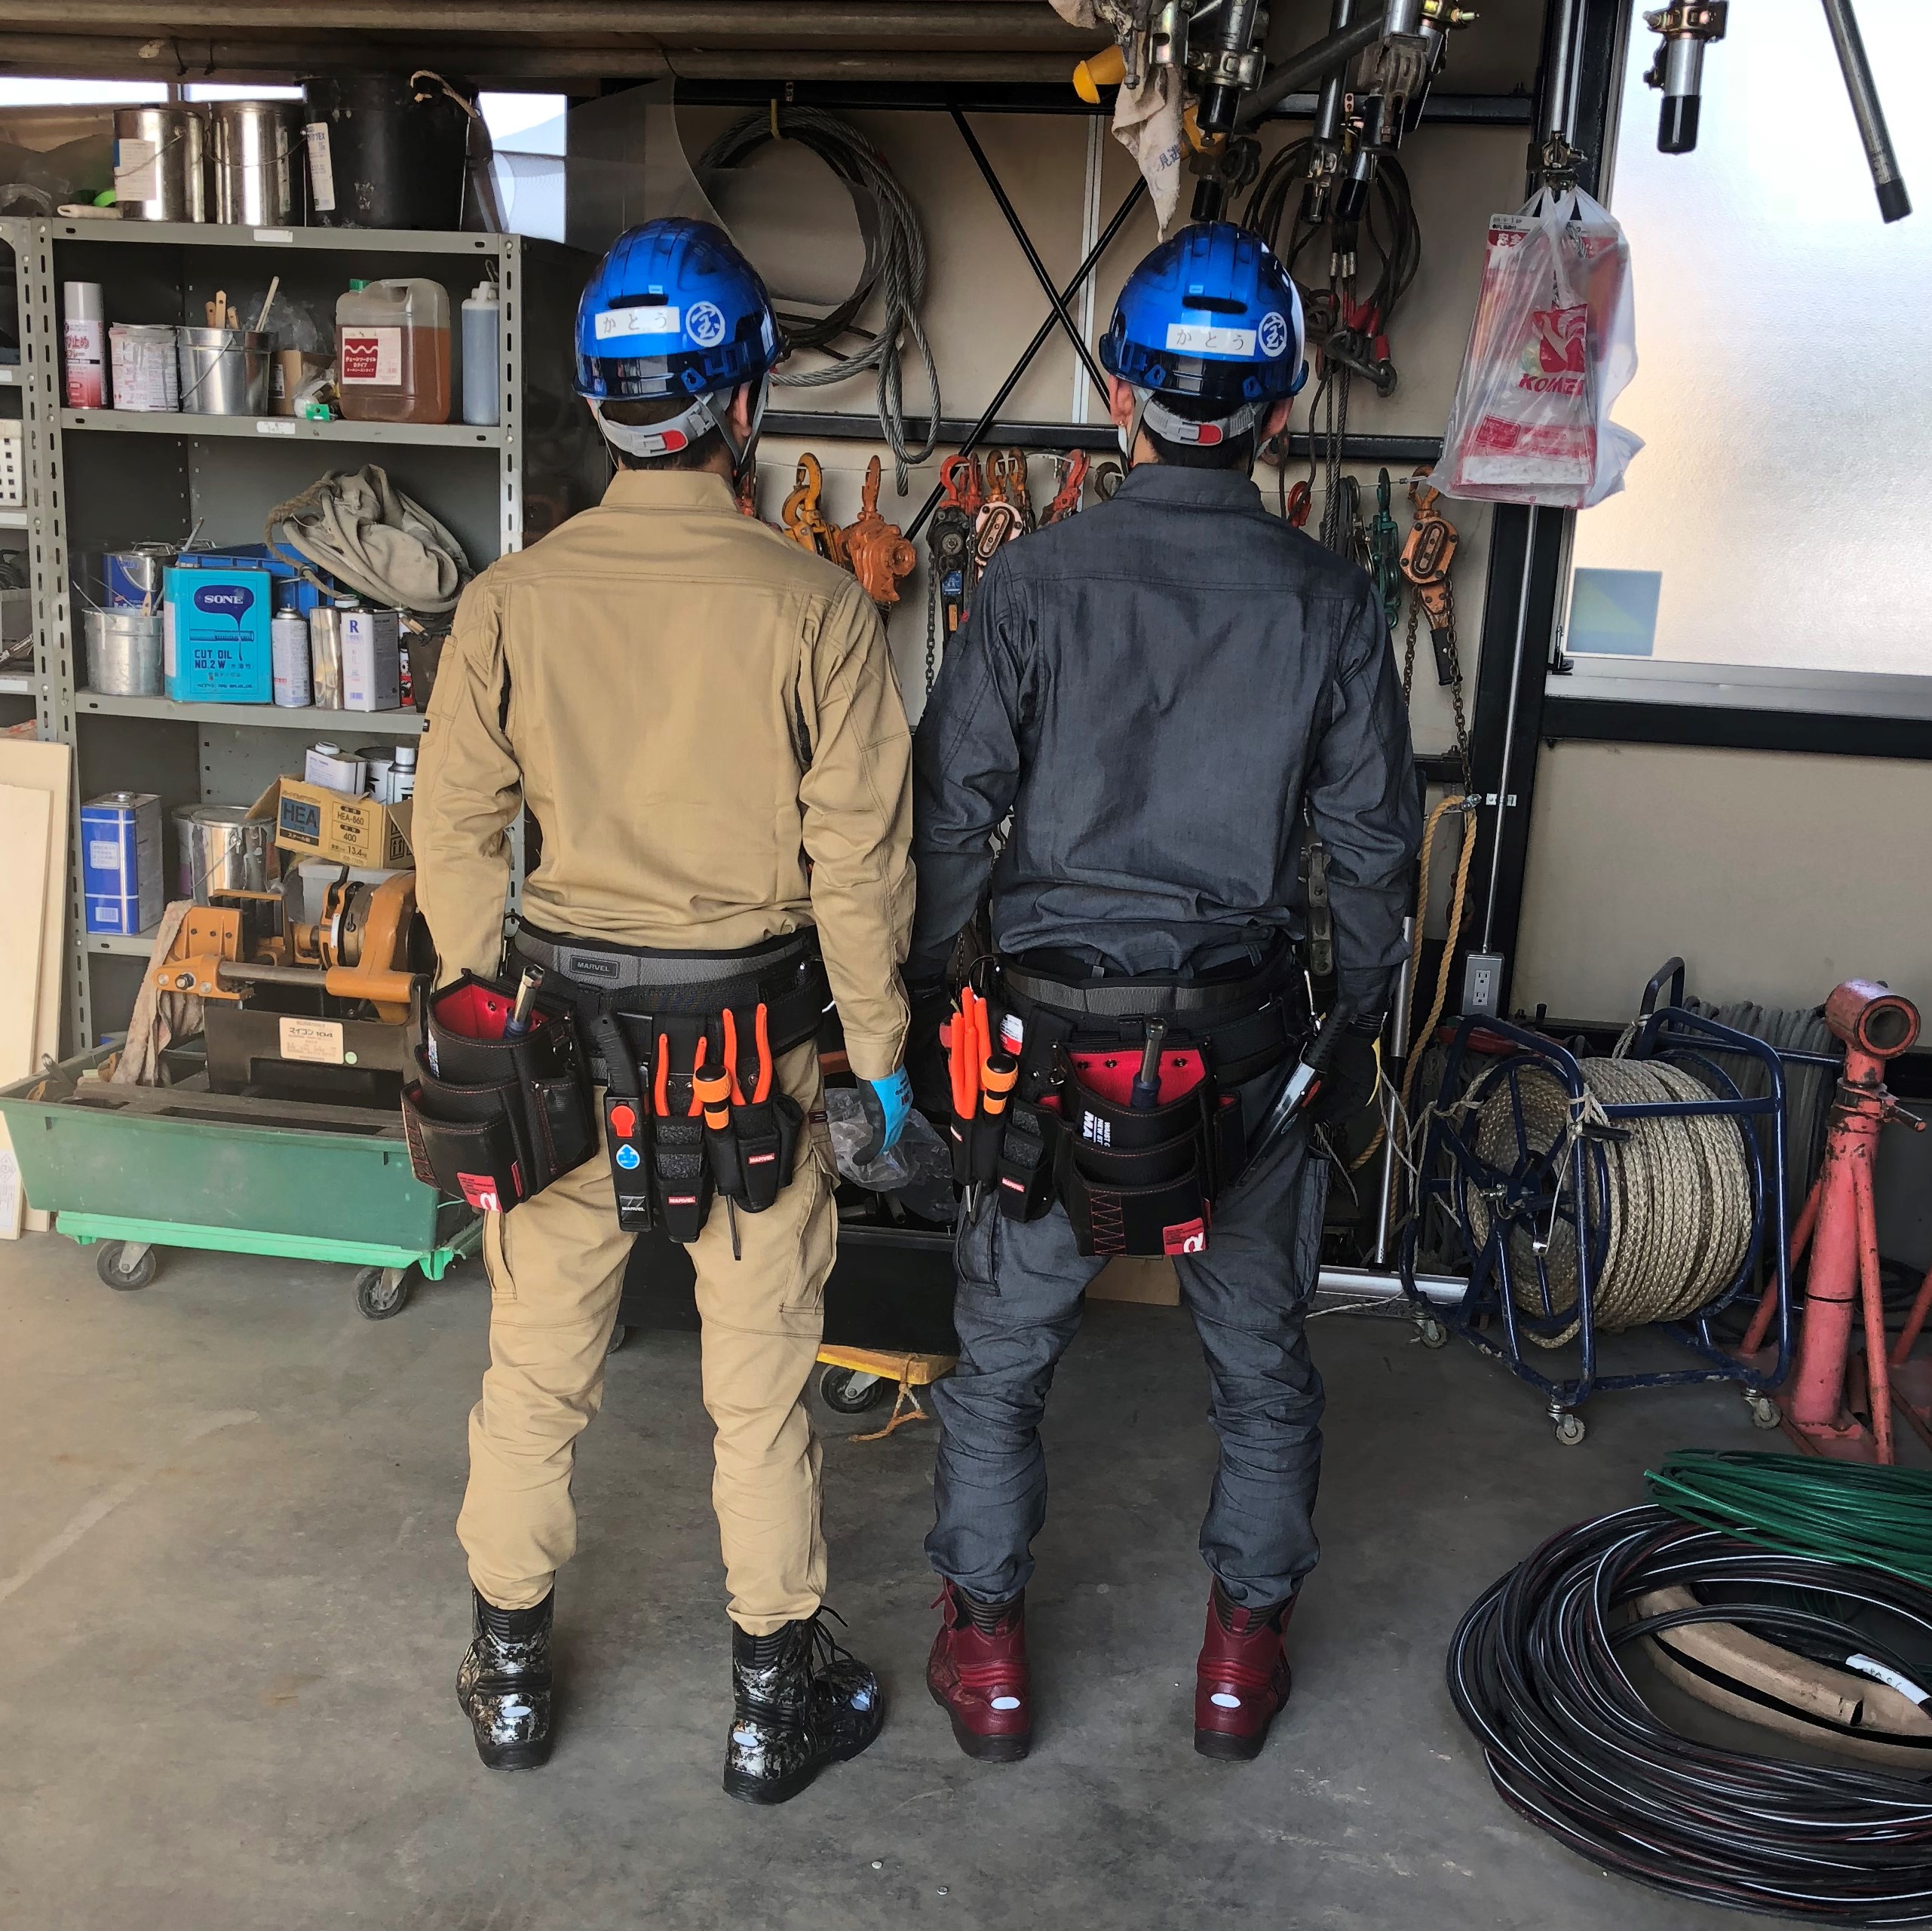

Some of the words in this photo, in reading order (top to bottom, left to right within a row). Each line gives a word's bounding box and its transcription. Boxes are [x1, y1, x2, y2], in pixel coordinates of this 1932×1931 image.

[1176, 329, 1244, 351] かとう
[204, 594, 244, 604] SONE
[349, 619, 360, 633] R
[194, 649, 213, 658] CUT
[217, 650, 232, 659] OIL
[195, 660, 216, 669] NO.2
[218, 660, 226, 669] W
[283, 802, 318, 829] HEA
[337, 811, 364, 826] HEA-860
[343, 832, 357, 843] 400
[577, 961, 610, 972] MARVEL
[289, 1027, 314, 1035] マイコン
